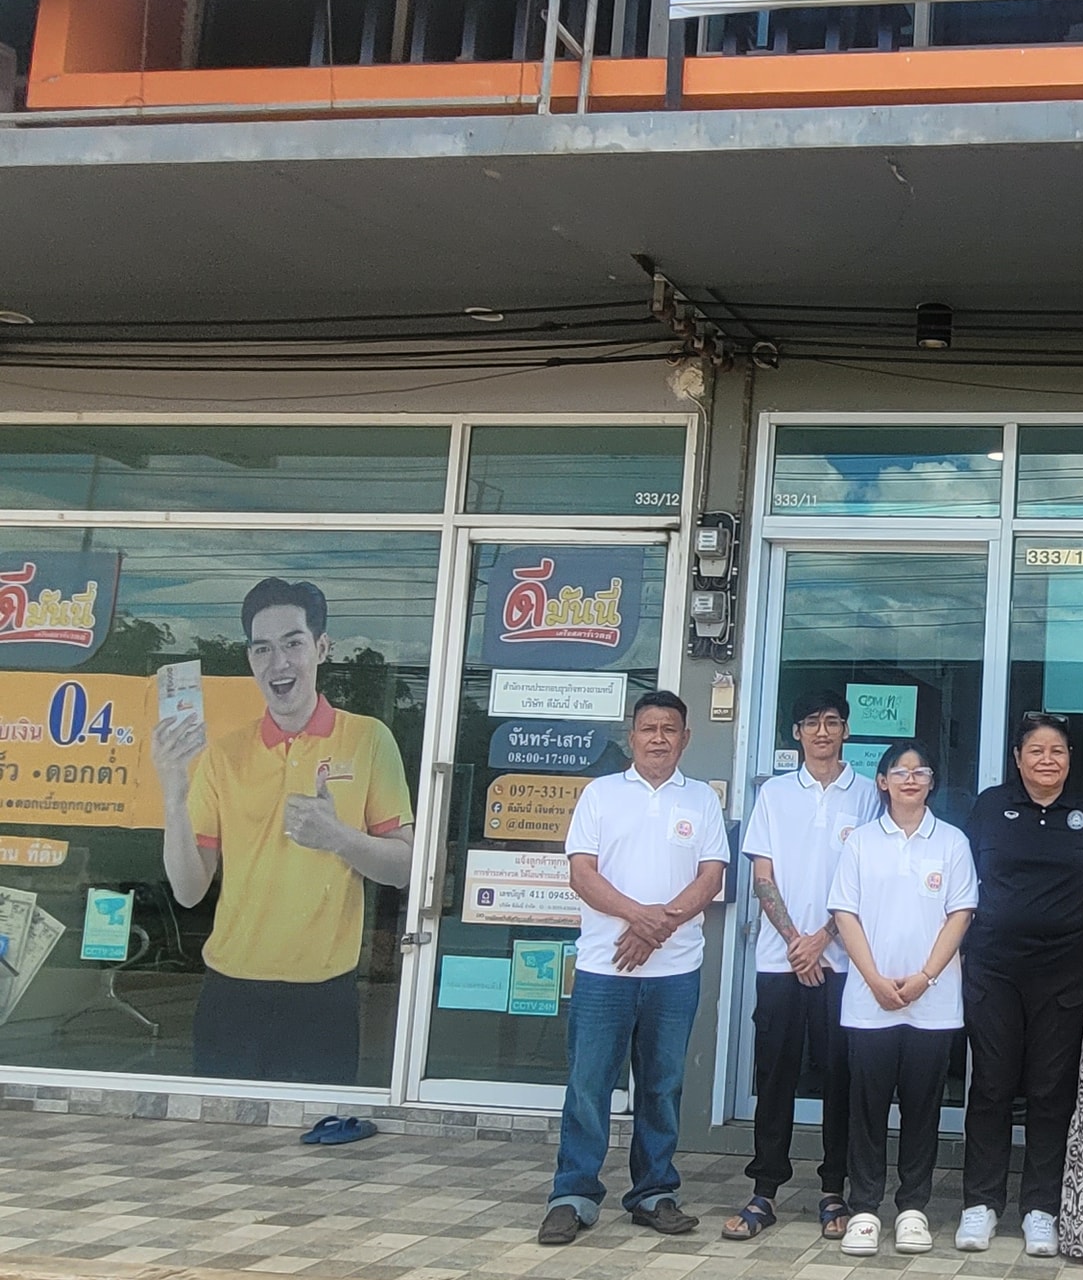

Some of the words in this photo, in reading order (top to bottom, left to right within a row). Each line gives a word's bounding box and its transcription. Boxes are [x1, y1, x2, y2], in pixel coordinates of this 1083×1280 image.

[634, 492, 680, 506] 333/12
[774, 493, 817, 507] 333/11
[503, 559, 622, 631] ดีมันนี่
[50, 680, 134, 746] 0.4%
[508, 726, 596, 749] จันทร์-เสาร์
[507, 751, 577, 765] 08:00-17:00
[506, 818, 561, 833] @dmoney
[529, 890, 545, 899] 411
[512, 1000, 538, 1011] CCTV
